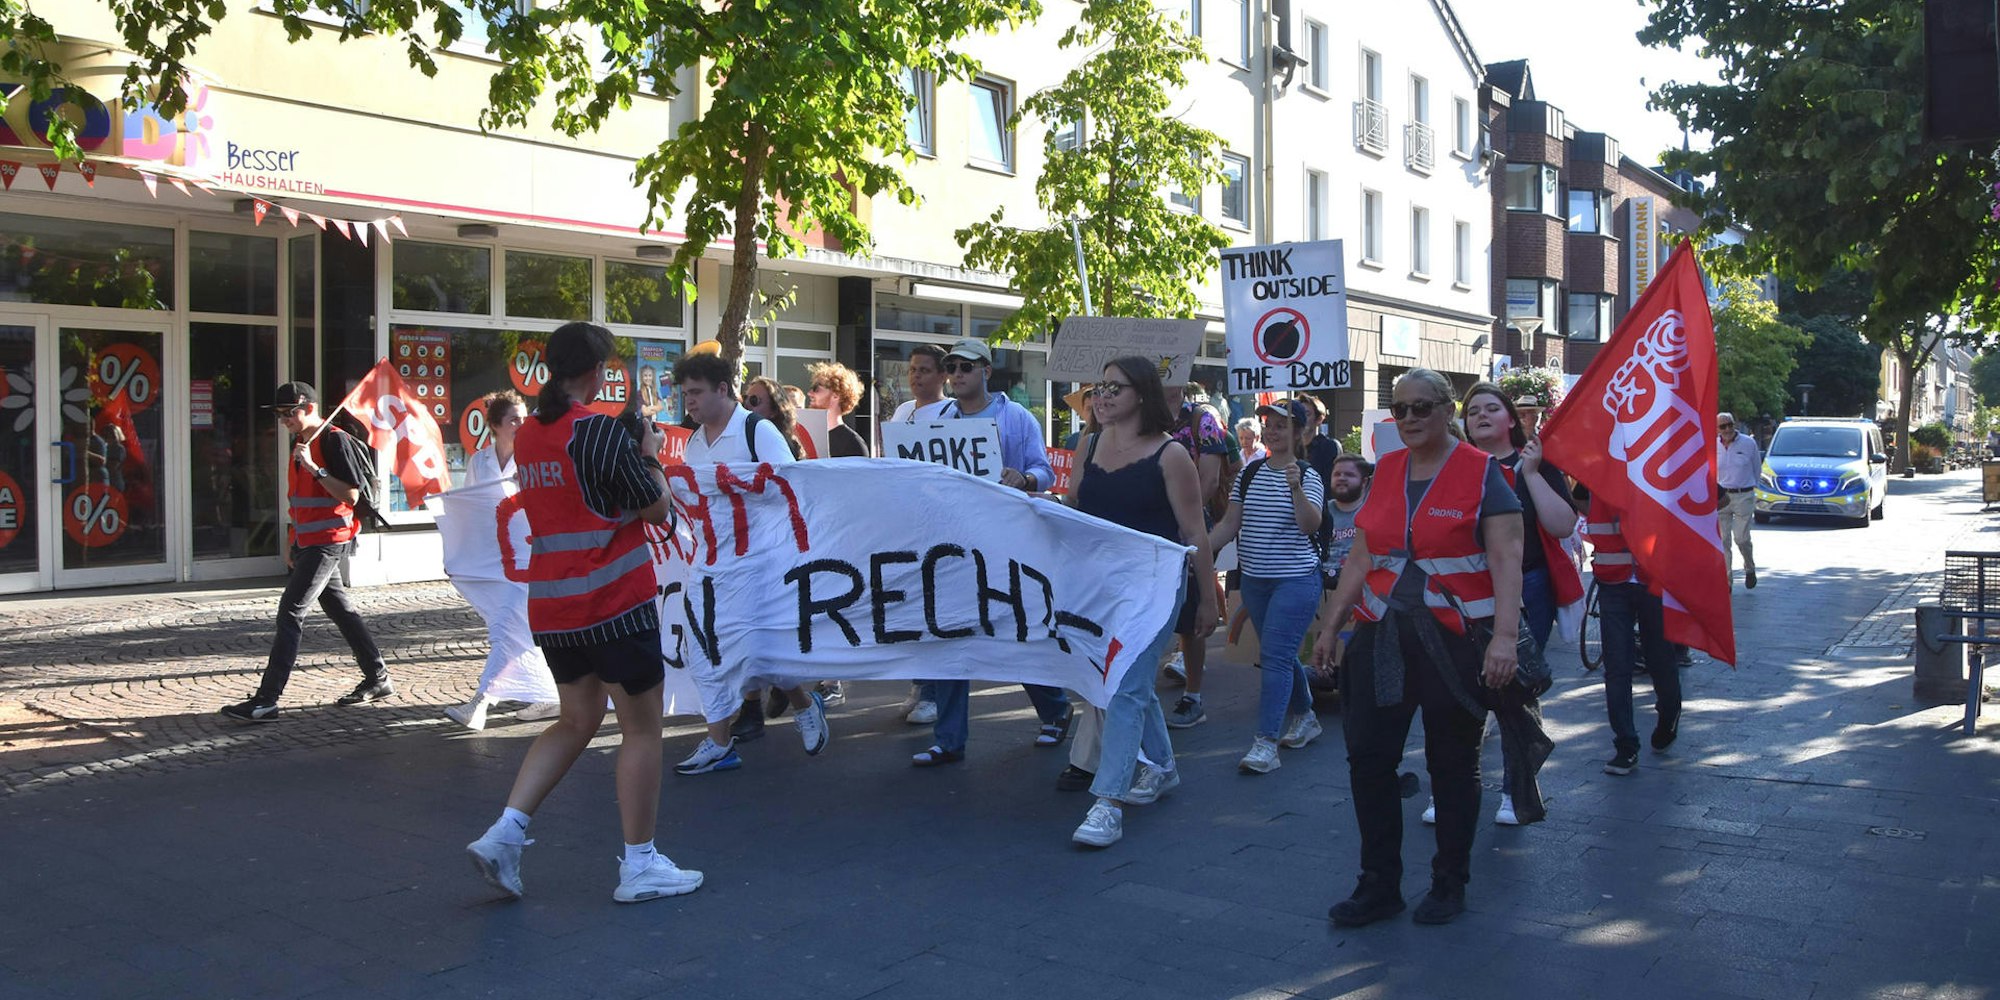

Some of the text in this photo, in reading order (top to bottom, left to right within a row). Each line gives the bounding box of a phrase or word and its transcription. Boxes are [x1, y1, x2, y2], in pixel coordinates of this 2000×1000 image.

[227, 140, 300, 171] Besser
[223, 171, 324, 195] HAUSHALTEN
[1636, 201, 1648, 295] MMERZBANK
[1221, 248, 1293, 280] THINK
[1252, 274, 1339, 301] OUTSIDE
[1061, 320, 1126, 342] NAZIS
[1231, 359, 1350, 391] THE BOMB
[594, 385, 626, 402] ALE
[371, 394, 444, 479] SPD
[897, 436, 990, 476] MAKE
[1428, 506, 1463, 520] ORDNER
